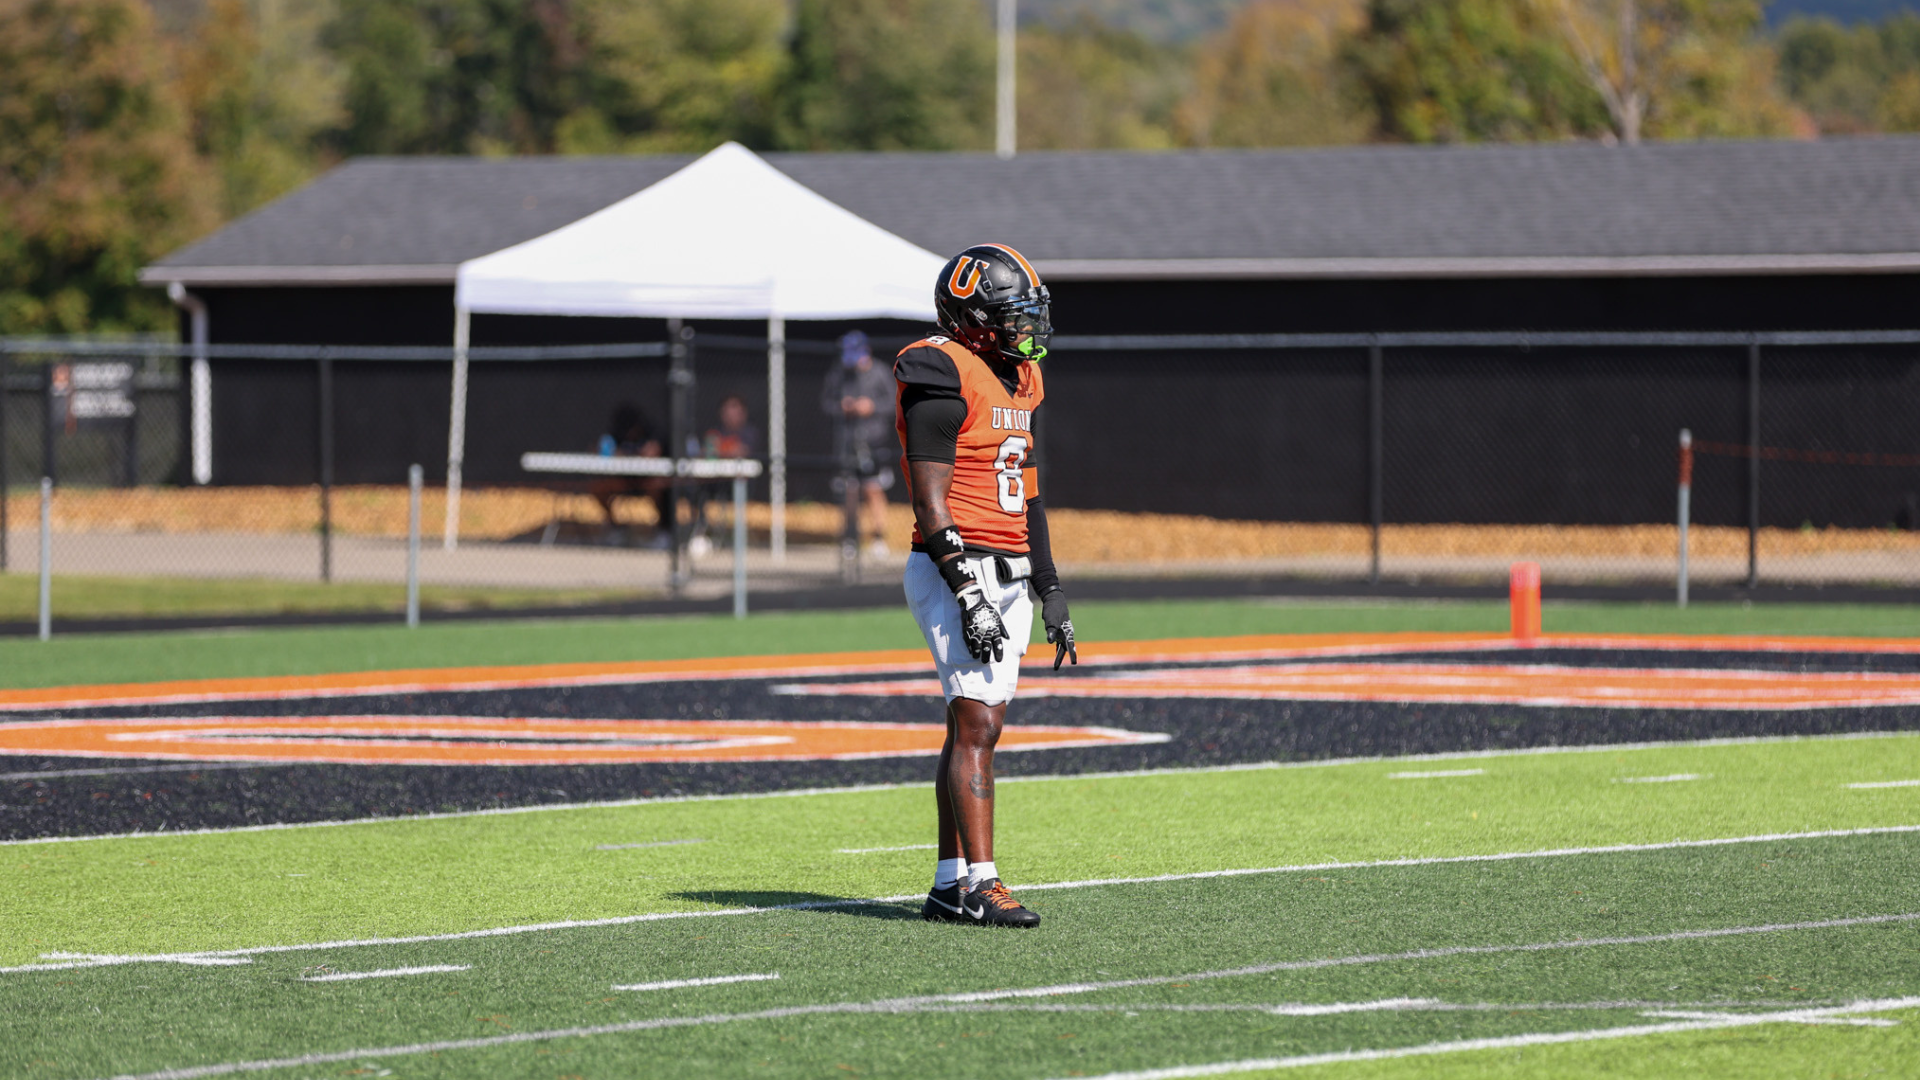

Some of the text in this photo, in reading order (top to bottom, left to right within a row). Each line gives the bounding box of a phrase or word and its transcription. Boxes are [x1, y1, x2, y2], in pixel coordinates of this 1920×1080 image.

[948, 256, 990, 299] U
[991, 406, 1032, 432] UNION
[993, 435, 1028, 513] 8
